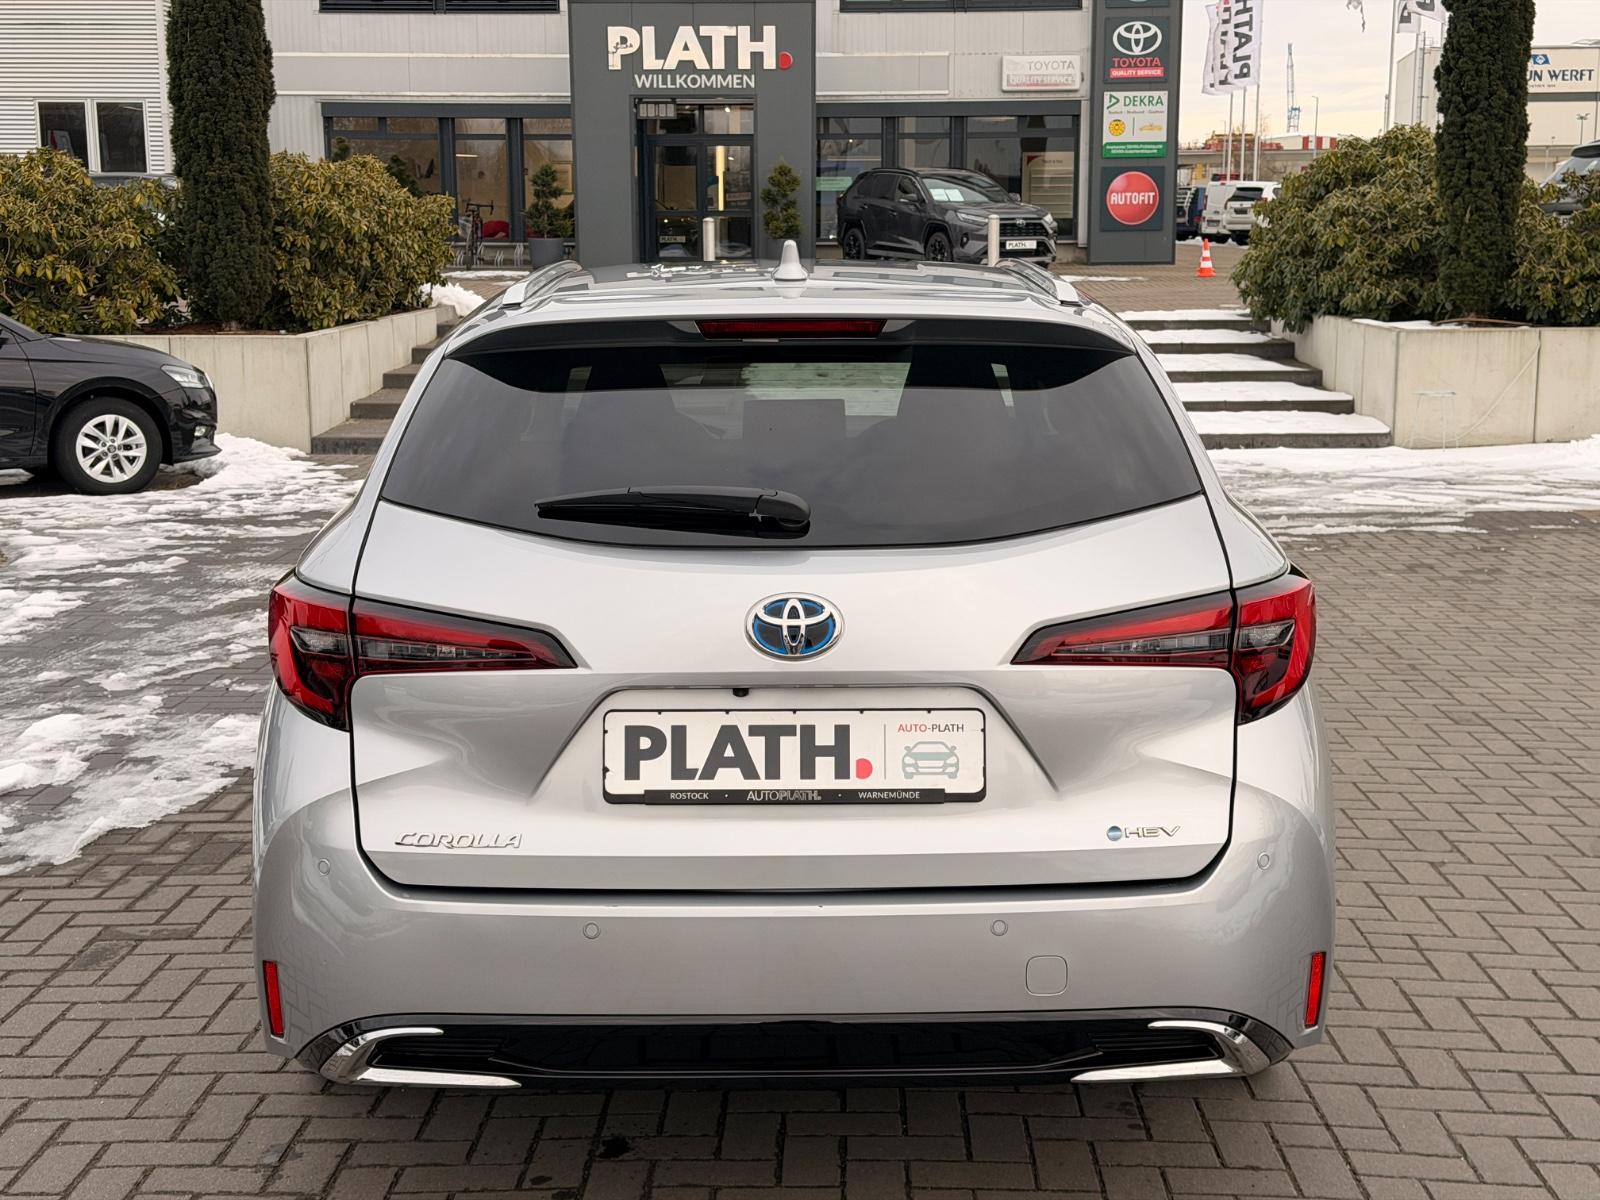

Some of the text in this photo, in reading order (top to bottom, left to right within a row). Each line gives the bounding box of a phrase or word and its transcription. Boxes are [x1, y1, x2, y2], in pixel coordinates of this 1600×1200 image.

[1027, 60, 1075, 71] TOYOTA
[1112, 57, 1161, 67] TOYOTA
[634, 74, 755, 88] WILLKOMMEN
[1547, 69, 1594, 81] WERFT
[1123, 95, 1164, 107] DEKRA
[1110, 192, 1155, 205] AUTOFIT
[897, 723, 965, 733] AUTO-PLATH
[670, 792, 709, 800] ROSTOCK
[858, 790, 921, 799] WARNEMÜNDE
[1124, 825, 1180, 838] HEV
[395, 832, 523, 849] COROLLA
